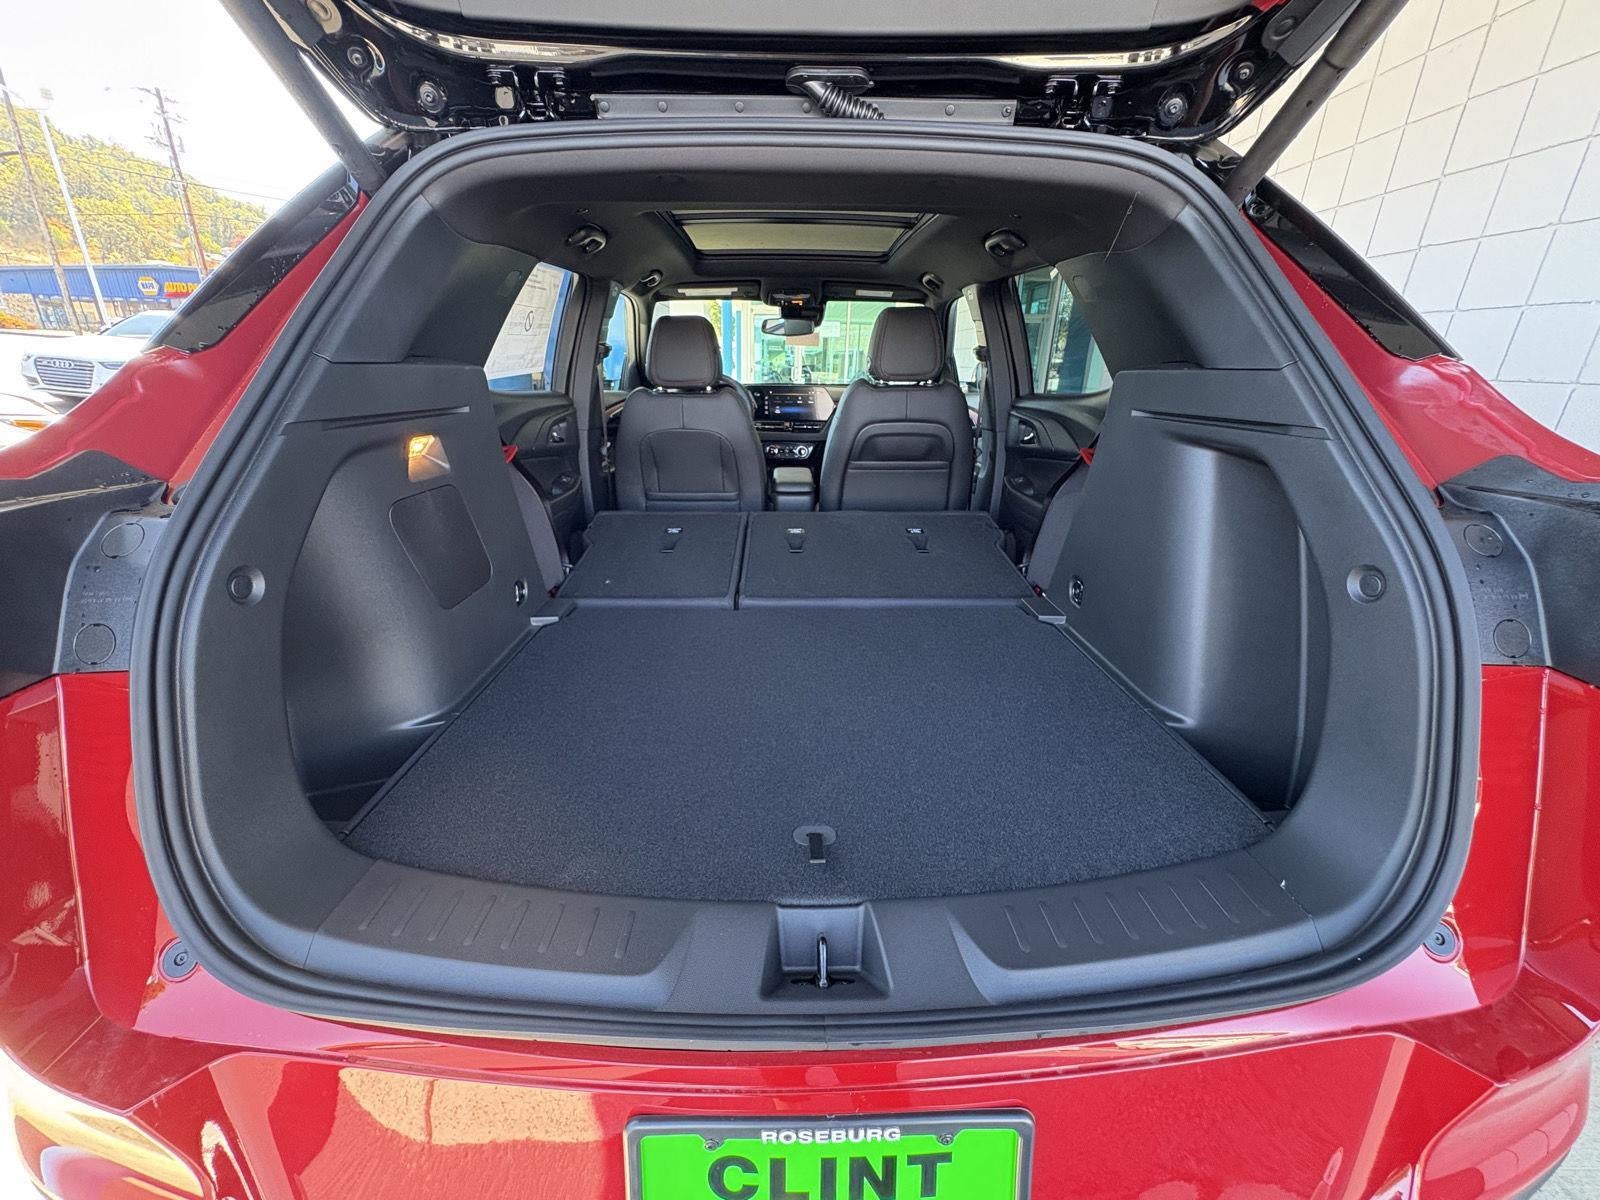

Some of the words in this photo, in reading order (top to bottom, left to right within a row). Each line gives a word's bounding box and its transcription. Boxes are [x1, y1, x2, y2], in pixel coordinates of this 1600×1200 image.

[165, 282, 188, 292] AUTO
[760, 1126, 902, 1145] ROSEBURG
[707, 1152, 953, 1200] CLINT
